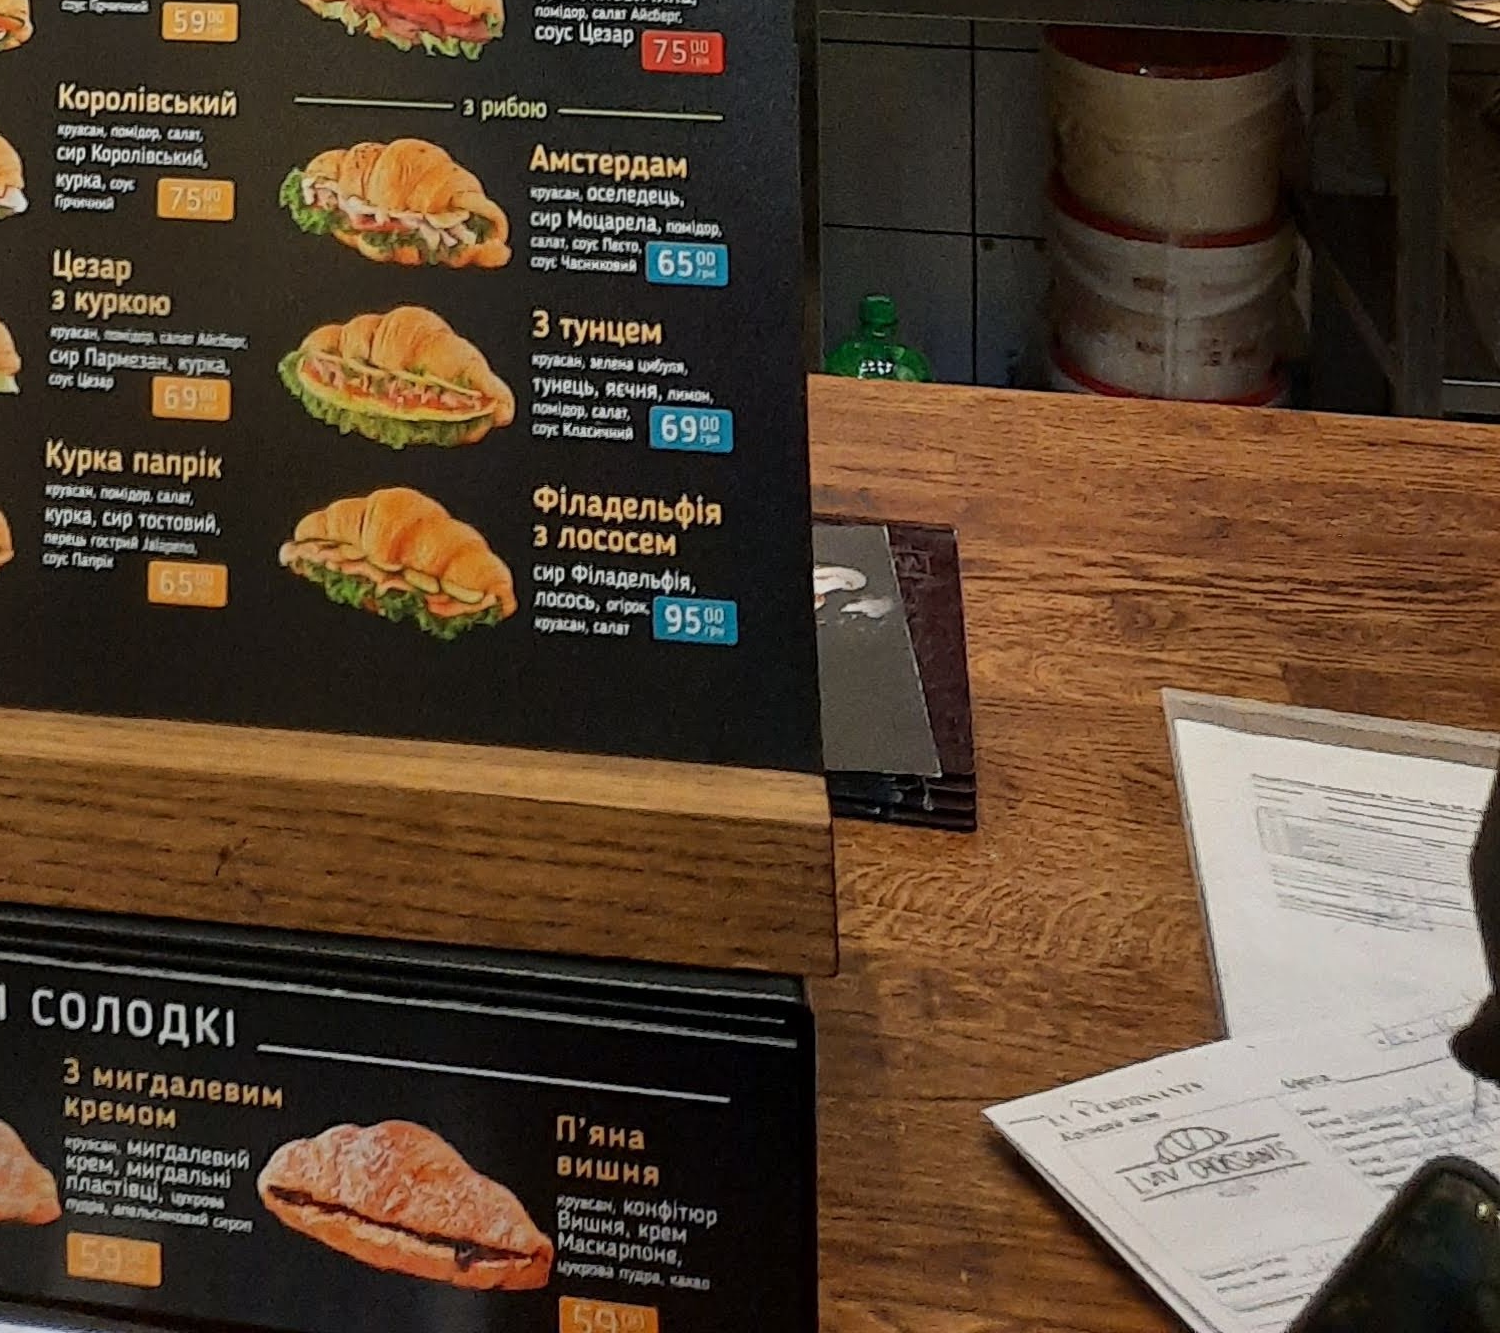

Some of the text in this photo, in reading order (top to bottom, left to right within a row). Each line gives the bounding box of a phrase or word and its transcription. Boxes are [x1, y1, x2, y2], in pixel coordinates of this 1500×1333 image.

[535, 25, 635, 48] соус Цезар
[58, 83, 237, 117] Королівський
[482, 95, 548, 122] рибою
[57, 144, 208, 169] сир Королівський,
[530, 143, 688, 181] Амстердам
[53, 249, 132, 286] Цезар
[75, 290, 171, 319] куркою
[559, 317, 662, 347] тунцем
[45, 438, 222, 483] Курка папрік
[533, 485, 722, 530] Філадельфія
[558, 527, 676, 556] лососем
[533, 564, 697, 594] сир Філадельфія,
[31, 987, 238, 1049] СОЛОДКІ
[92, 1067, 284, 1108] мигдалевим
[64, 1095, 178, 1130] кремом
[557, 1153, 660, 1187] вишня
